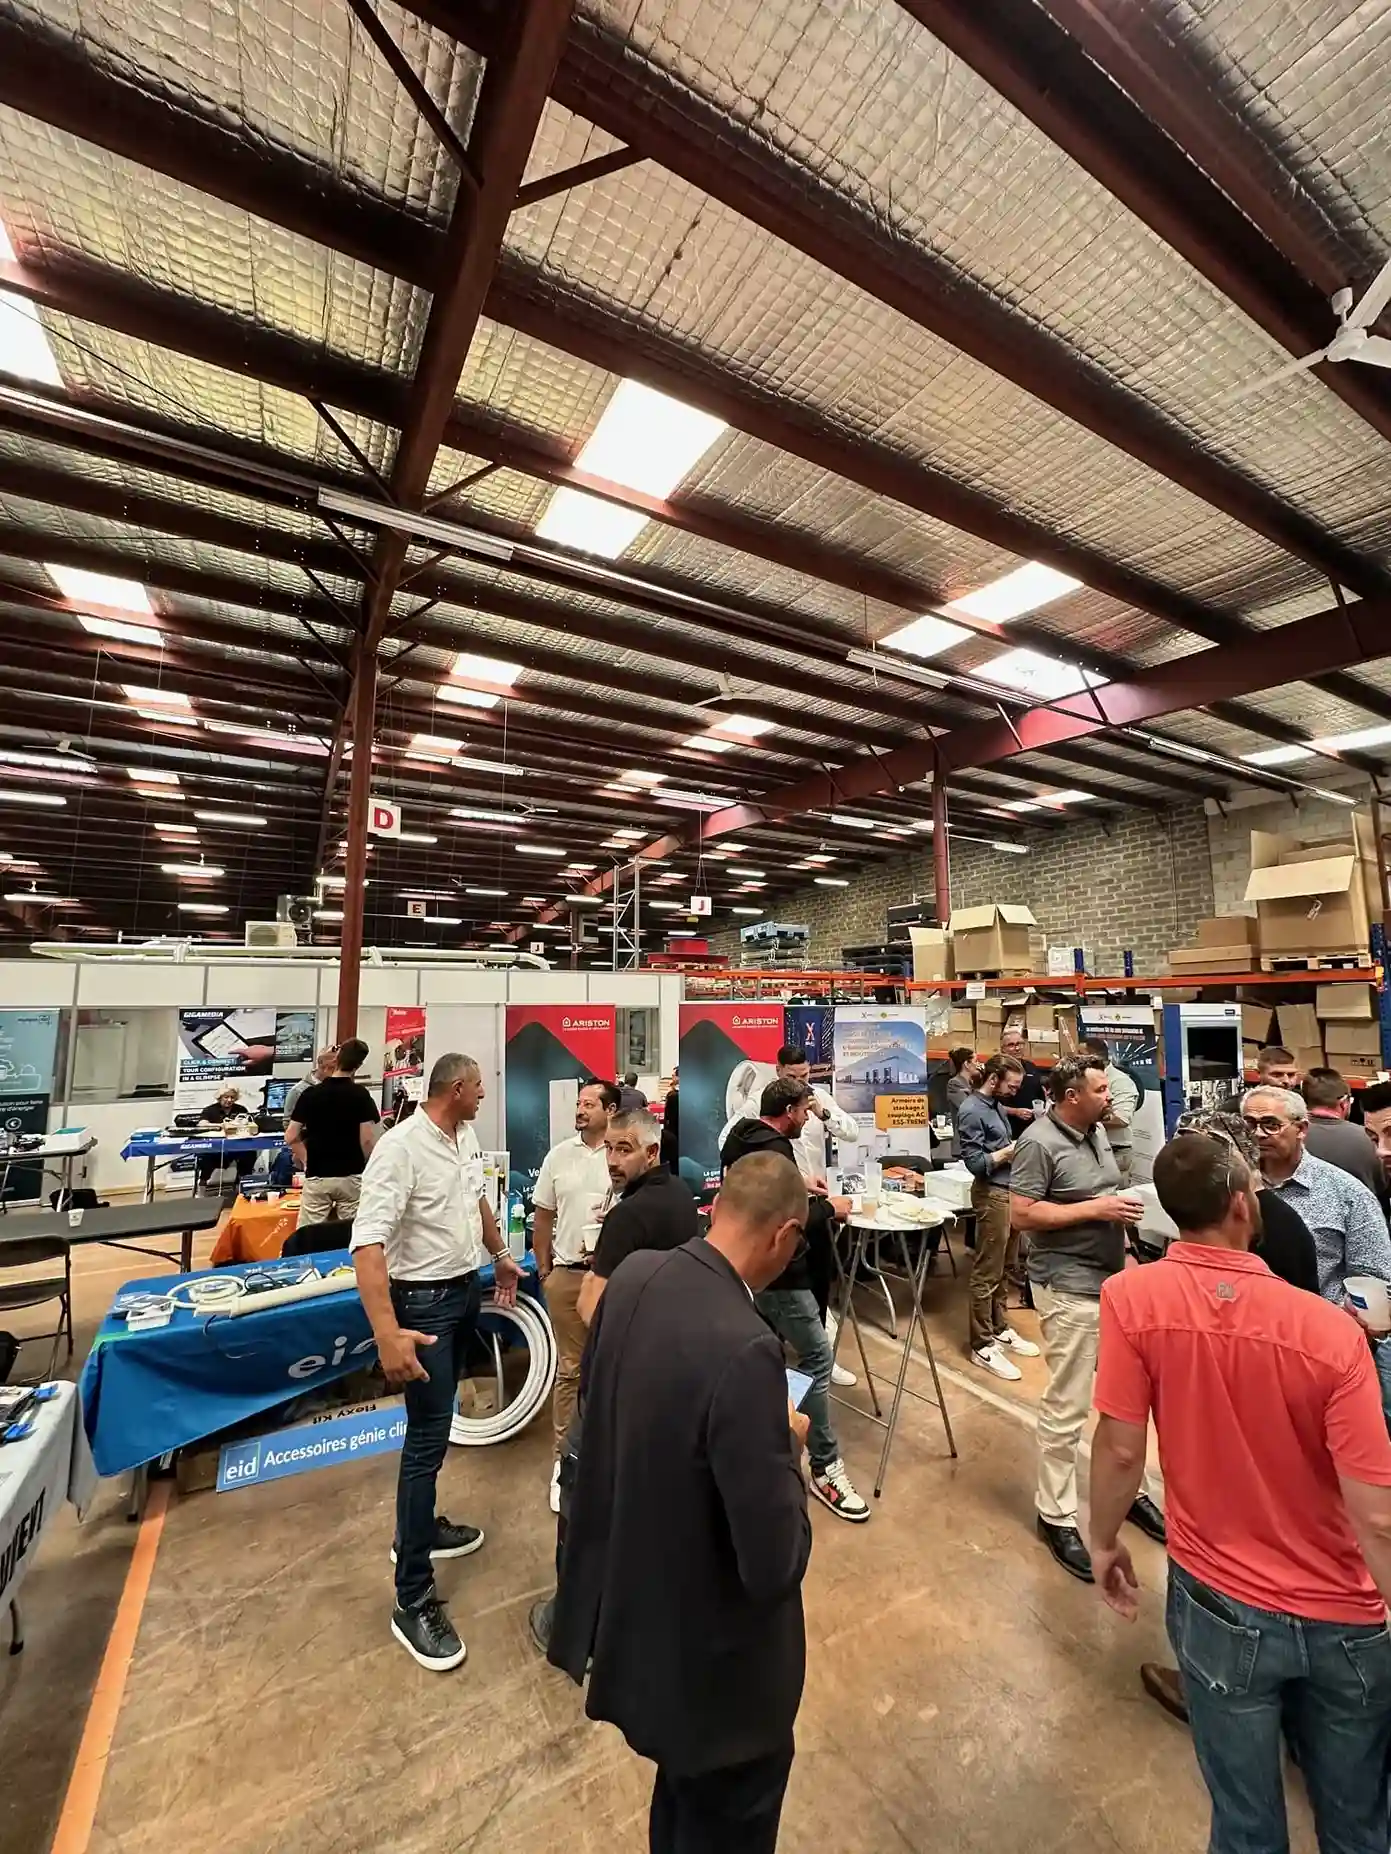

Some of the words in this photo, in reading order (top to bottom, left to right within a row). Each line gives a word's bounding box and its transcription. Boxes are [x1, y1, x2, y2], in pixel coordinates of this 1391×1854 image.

[374, 806, 394, 829] D
[412, 904, 422, 913] E
[698, 899, 705, 911] J
[572, 1019, 610, 1027] ARISTON
[741, 1017, 779, 1025] ARISTON
[263, 1437, 347, 1469] Accessoires
[350, 1427, 387, 1450] génie
[226, 1456, 257, 1480] eid
